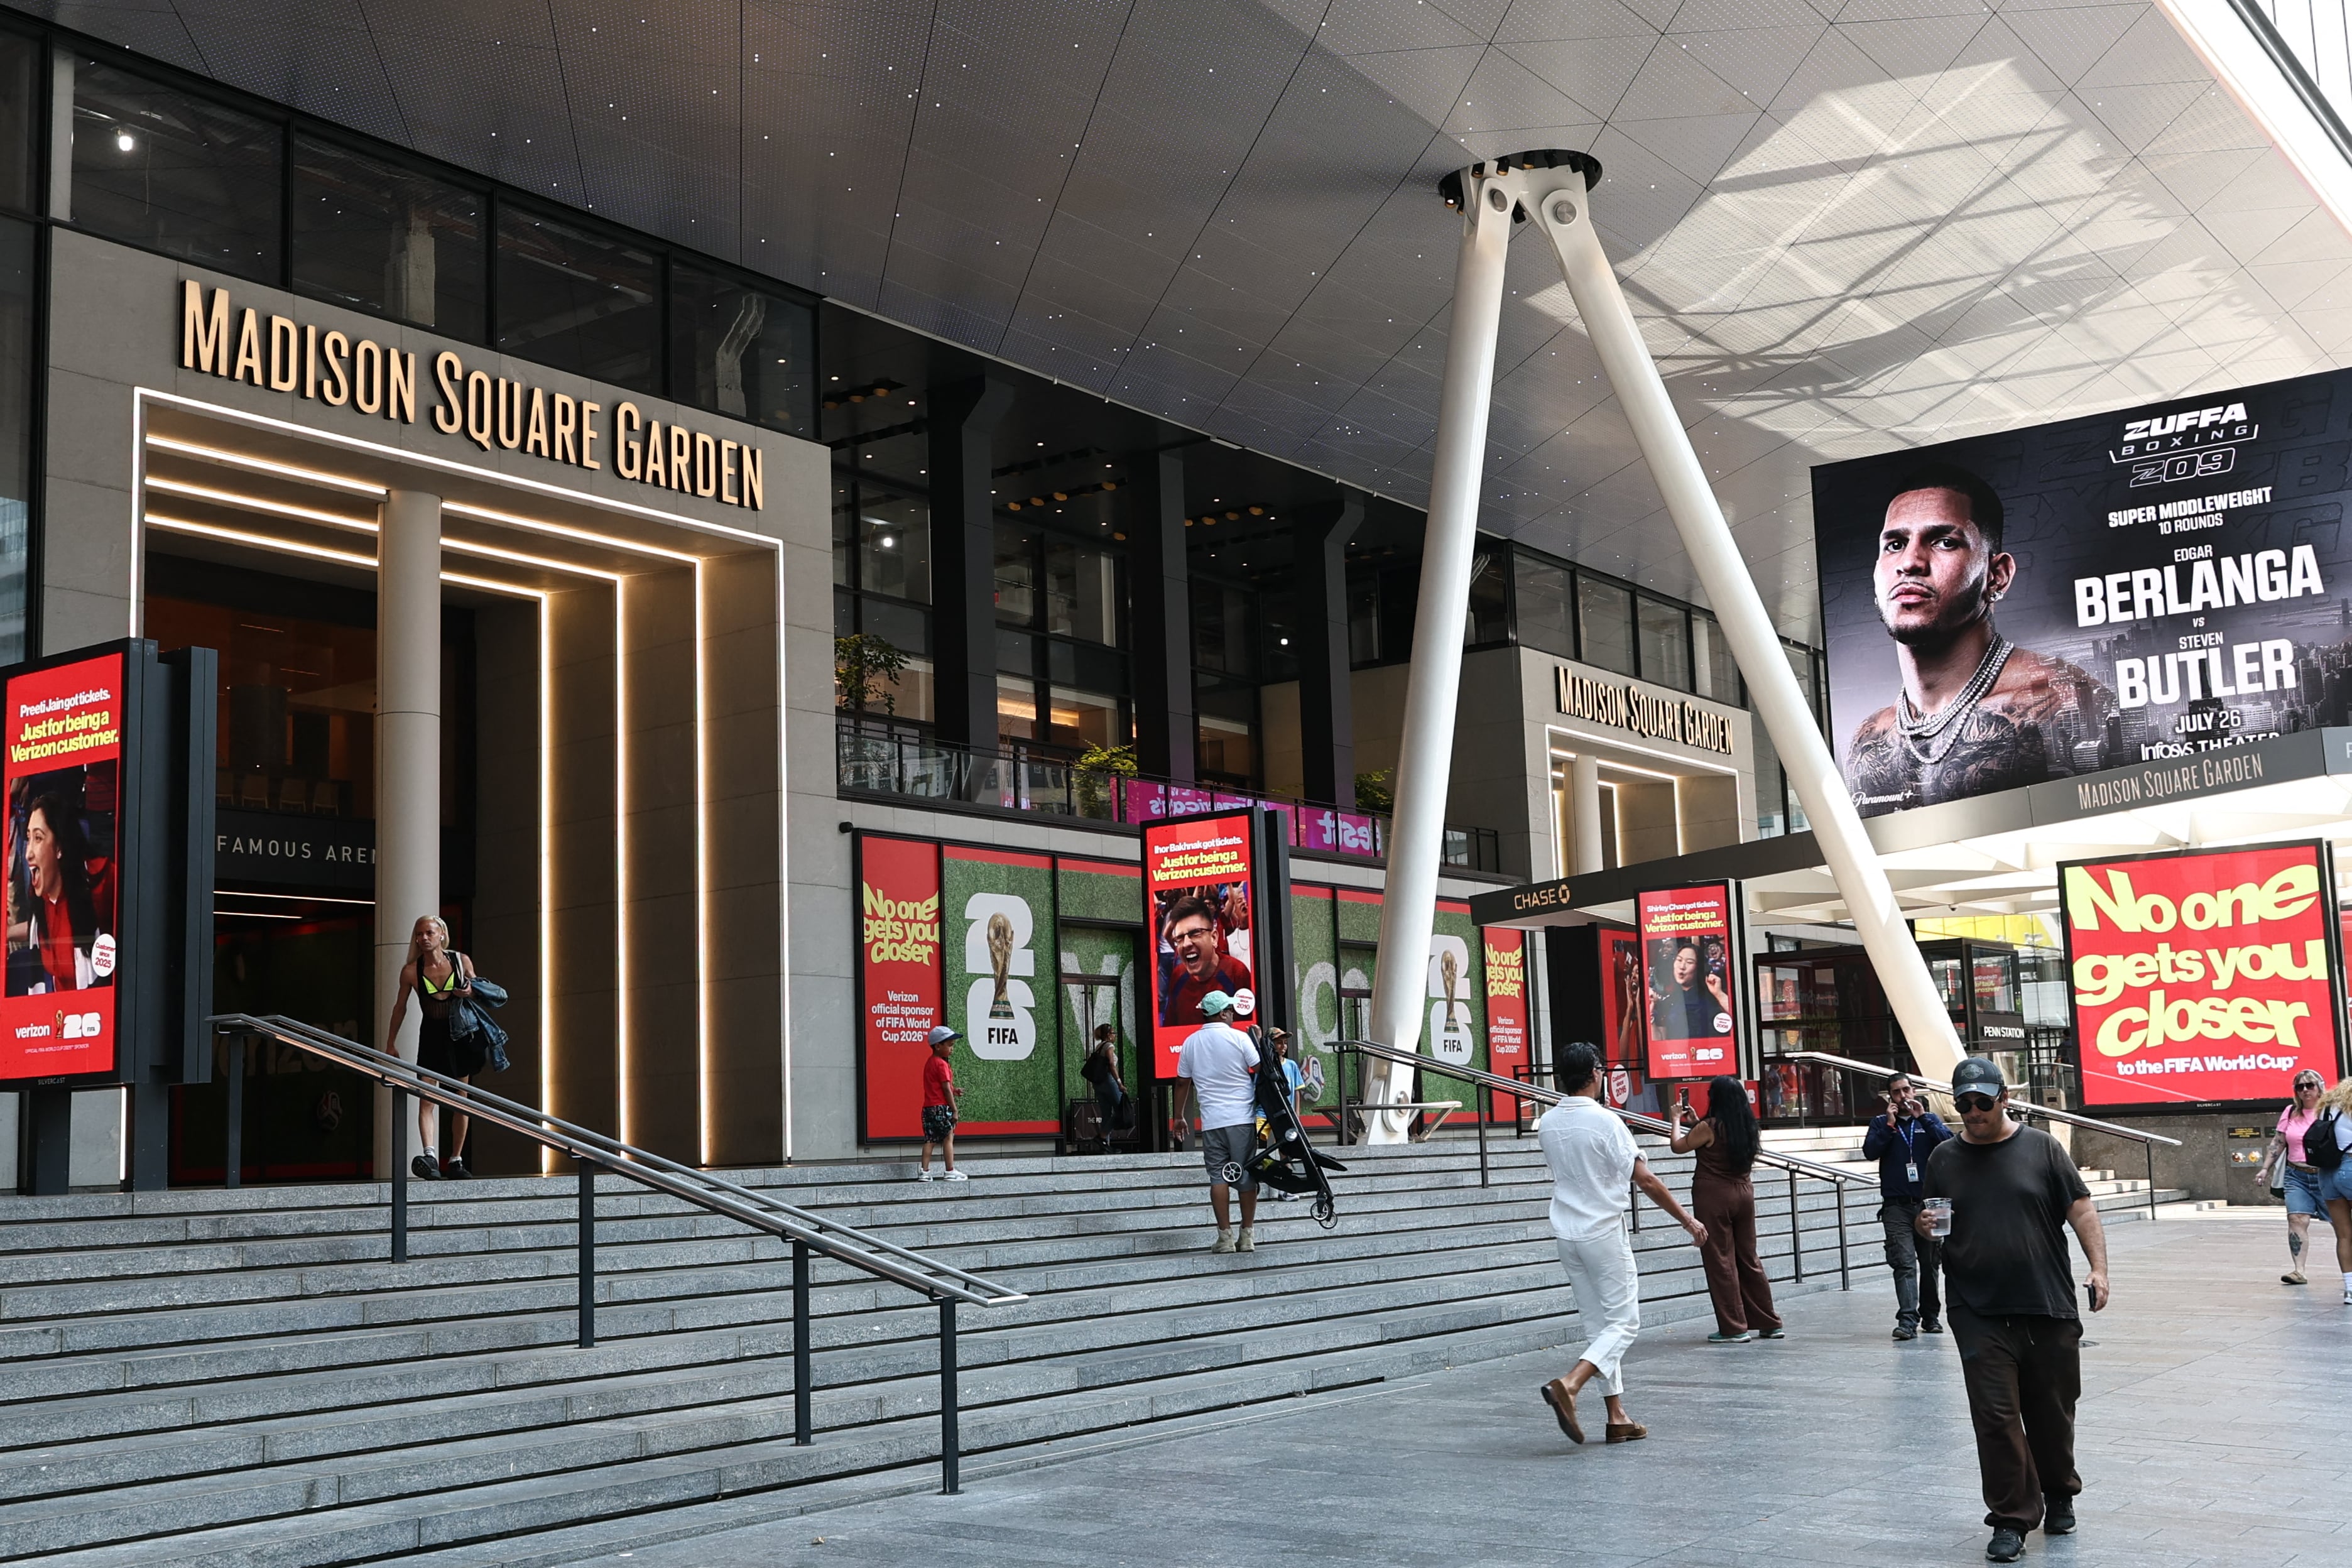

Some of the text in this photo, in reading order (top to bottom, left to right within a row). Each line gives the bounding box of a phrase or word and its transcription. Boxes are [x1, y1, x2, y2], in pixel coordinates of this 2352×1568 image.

[180, 280, 763, 511] MADISON SQUARE GARDEN
[2123, 402, 2248, 441] ZUFFA
[2121, 425, 2248, 456] BOXING
[2130, 447, 2236, 488] Z09
[2108, 486, 2272, 528] SUPER MIDDLEWEIGHT
[2158, 513, 2224, 535] 10 ROUNDS
[2174, 545, 2213, 562] EDGAR
[2074, 544, 2324, 628] BERLANGA
[2192, 617, 2205, 628] VS
[2179, 631, 2223, 650] STEVEN
[2115, 638, 2296, 709] BUTLER
[20, 688, 111, 717] Preeti Jain got tickets.
[1557, 666, 1733, 754] MADISON SQUARE GARDEN
[20, 710, 109, 741] Just for being a
[2175, 709, 2241, 734] JULY 26
[11, 729, 119, 763] Verizon customer.
[2140, 741, 2194, 761] Infosys
[2077, 753, 2263, 810] MADISON SQUARE GARDEN
[217, 835, 312, 859] FAMOUS
[1202, 841, 1216, 849] got
[1216, 836, 1243, 845] tickets.
[1160, 851, 1238, 868] Just for being a
[1153, 863, 1247, 881] Verizon customer.
[863, 881, 939, 921] No one
[1514, 888, 1557, 910] CHASE
[2065, 864, 2319, 933] No one
[1645, 920, 1724, 933] Verizon customer.
[1652, 913, 1673, 923] Just
[1672, 913, 1685, 922] for
[1685, 911, 1710, 920] being
[864, 917, 940, 945] gets you
[871, 937, 934, 966] closer
[1485, 943, 1522, 966] No one
[95, 957, 111, 968] 2025
[2072, 939, 2329, 1006] gets you
[1505, 966, 1523, 983] you
[887, 990, 918, 1002] Verizon
[1488, 979, 1521, 999] closer
[871, 1003, 934, 1016] official sponsor
[16, 1023, 50, 1038] verizon
[63, 1012, 101, 1038] 26
[876, 1017, 930, 1028] of FIFA World
[1489, 1025, 1505, 1033] official
[1498, 1016, 1514, 1025] Verizon
[2096, 989, 2311, 1057] closer
[882, 1030, 899, 1043] Cup
[988, 1028, 1018, 1044] FIFA
[1498, 1035, 1508, 1043] FIFA
[1508, 1035, 1521, 1043] World
[1984, 1026, 2025, 1038] PENN STATION
[1444, 1039, 1462, 1053] FIFA
[1496, 1045, 1505, 1054] Cup
[2117, 1061, 2135, 1075] to
[2135, 1059, 2164, 1075] the
[2164, 1057, 2204, 1074] FIFA
[2204, 1055, 2255, 1072] World
